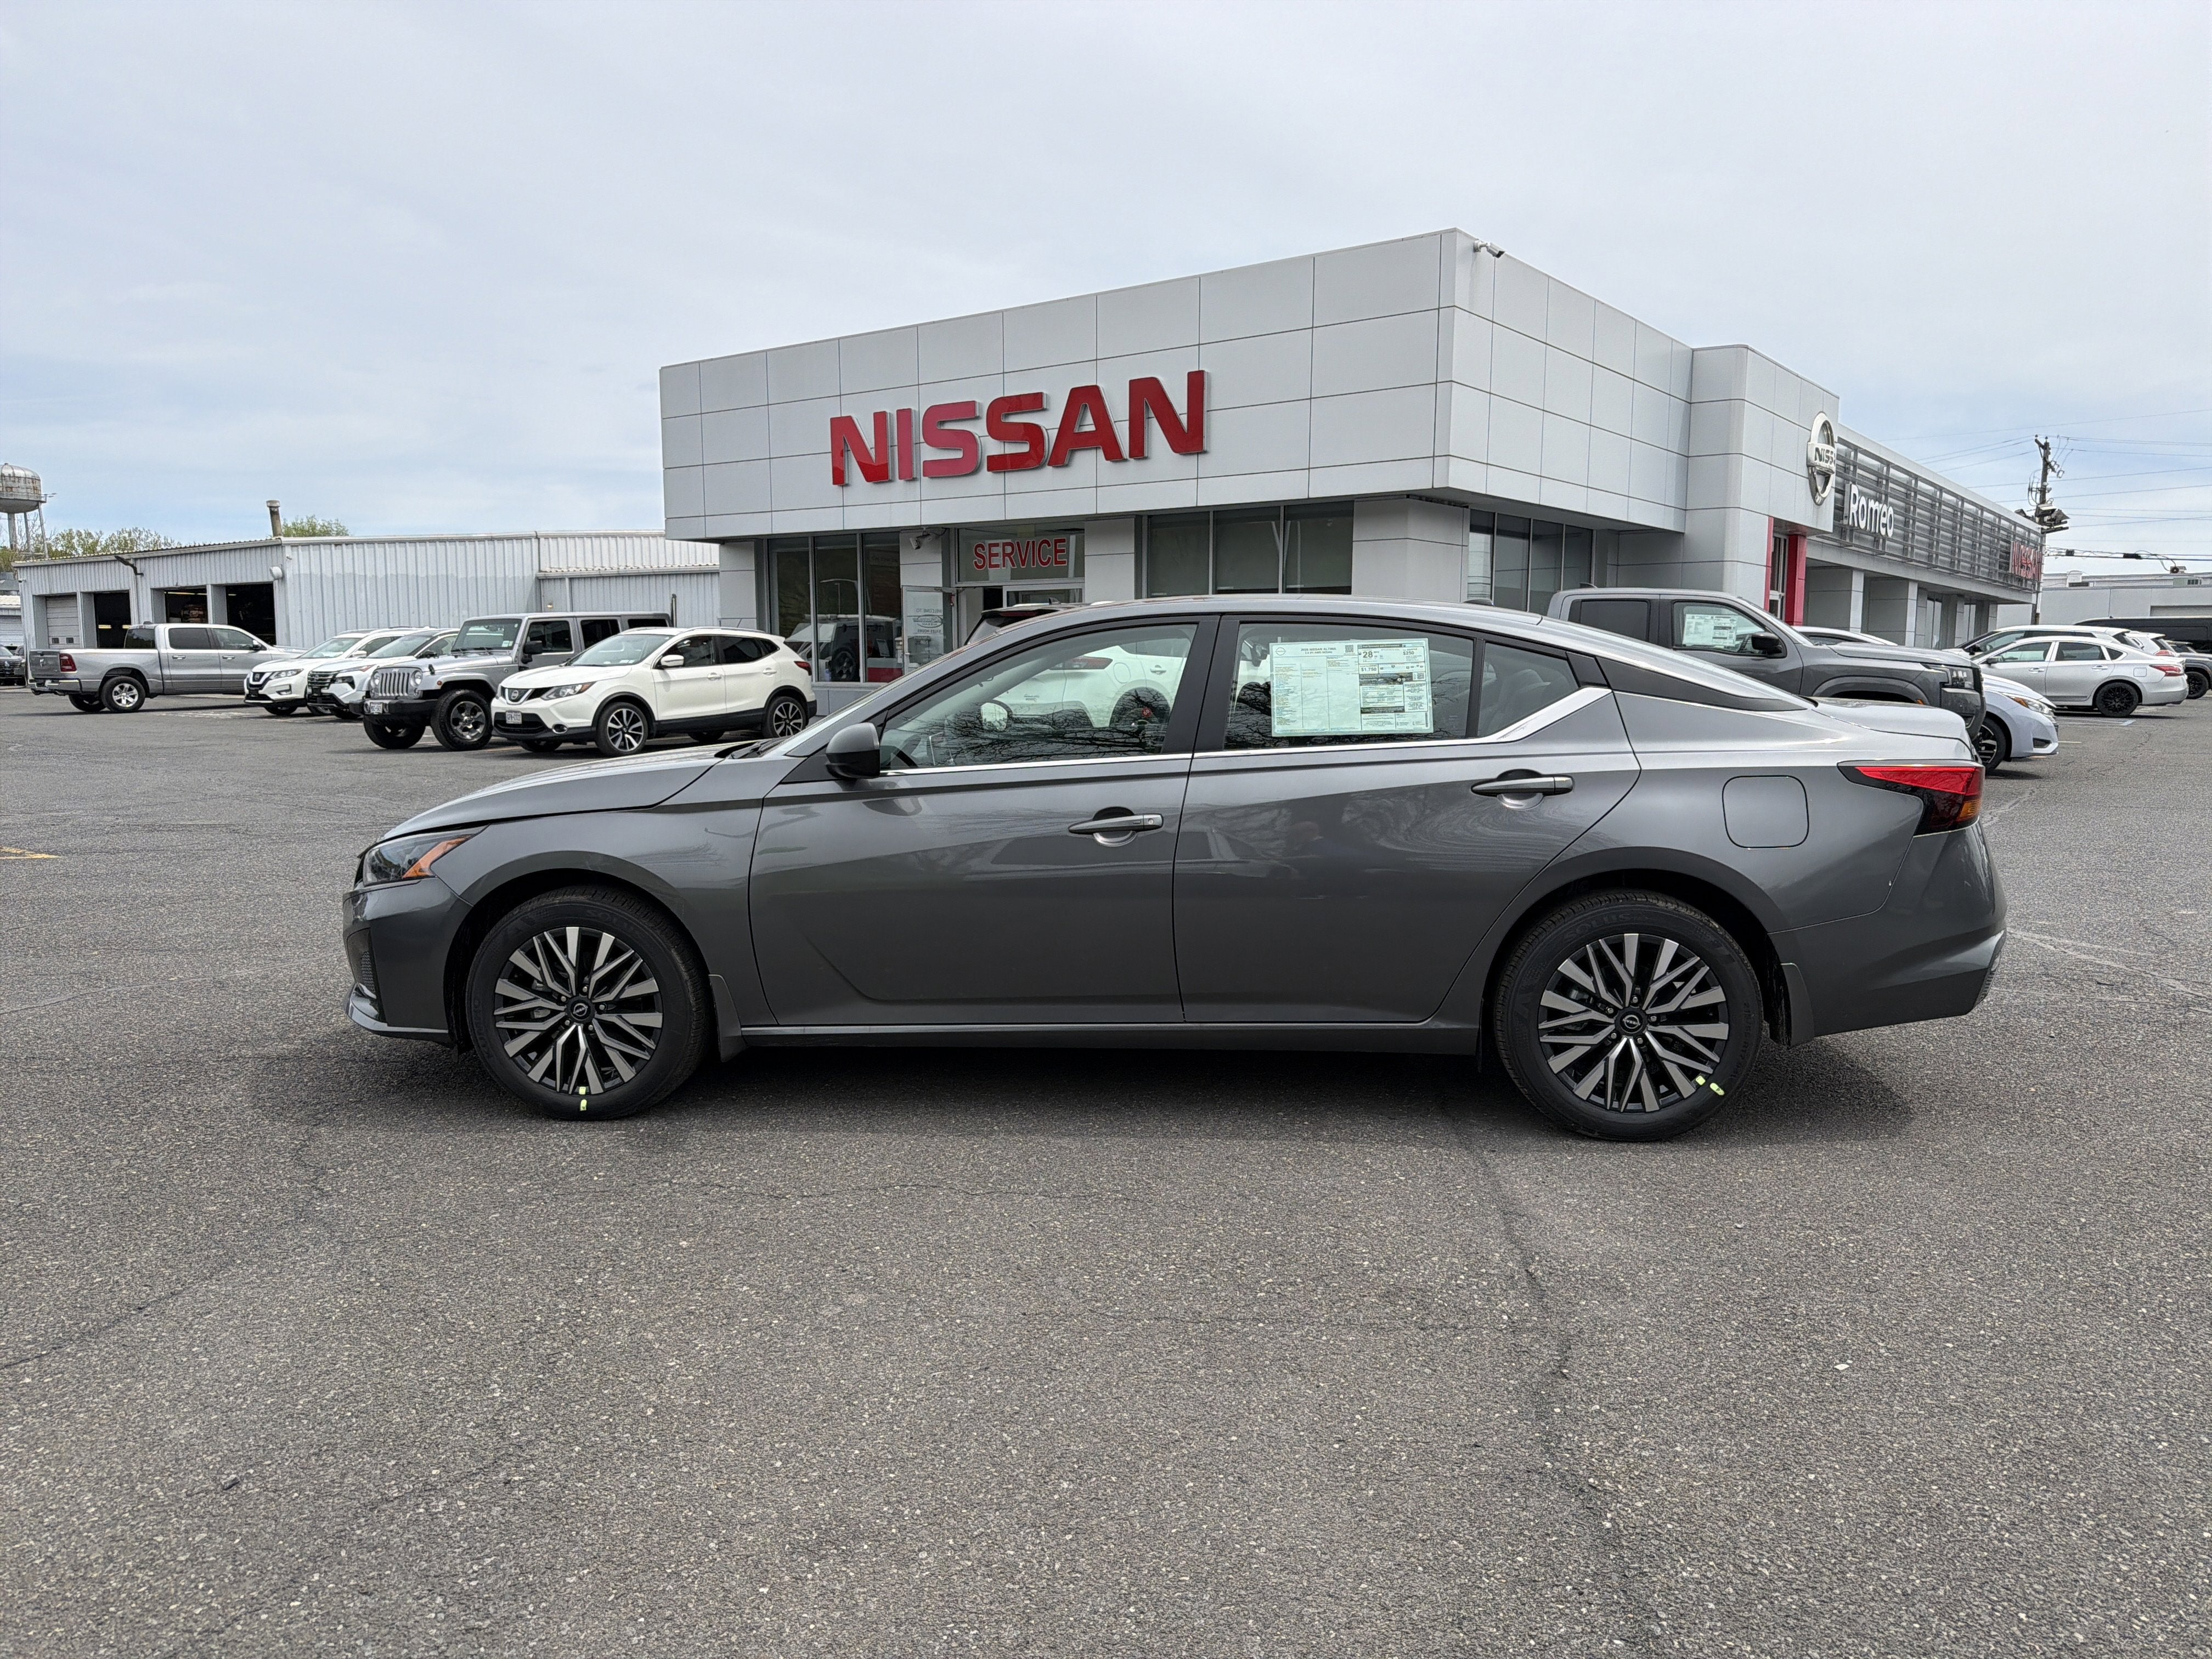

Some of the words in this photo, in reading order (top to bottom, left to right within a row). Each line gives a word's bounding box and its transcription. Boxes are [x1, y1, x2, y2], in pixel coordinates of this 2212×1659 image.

[830, 370, 1206, 486] NISSAN
[1849, 483, 1894, 538] Romeo
[973, 537, 1067, 571] SERVICE
[2011, 540, 2043, 582] NISSAN
